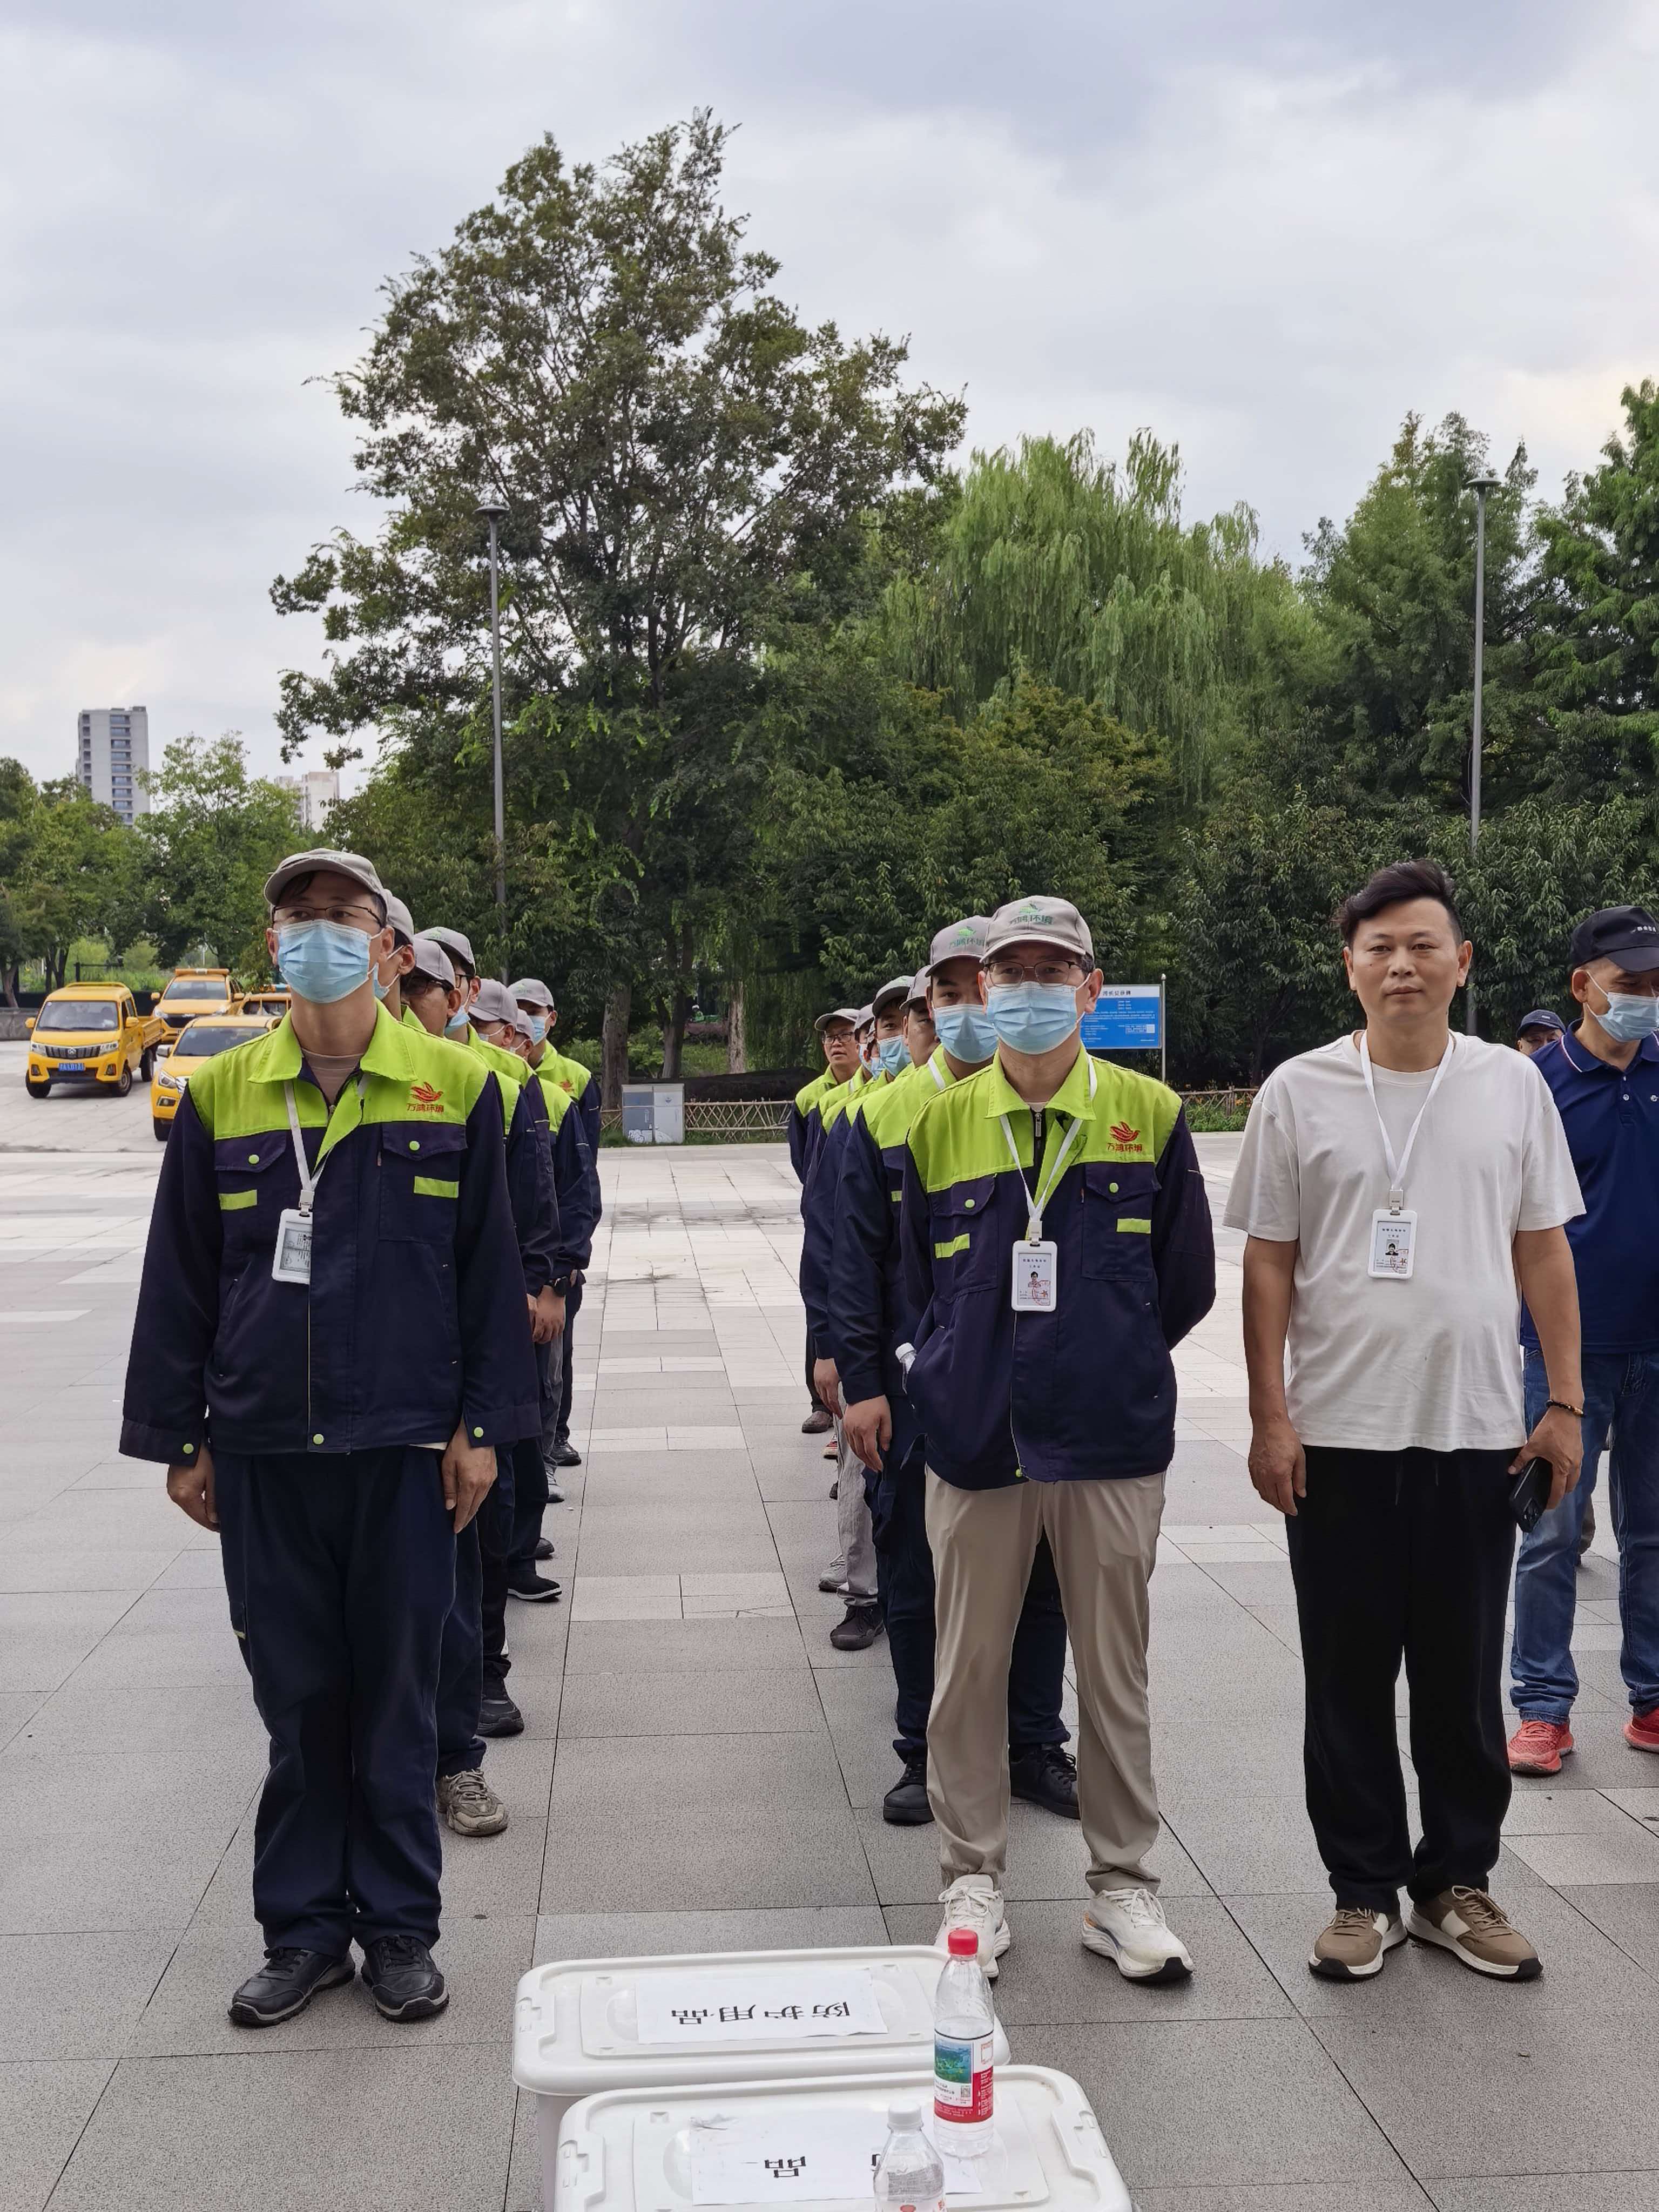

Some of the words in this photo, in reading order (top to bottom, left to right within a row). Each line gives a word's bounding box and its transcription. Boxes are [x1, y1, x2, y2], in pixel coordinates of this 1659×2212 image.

[671, 2001, 851, 2025] 防护用品
[764, 2156, 806, 2178] 品
